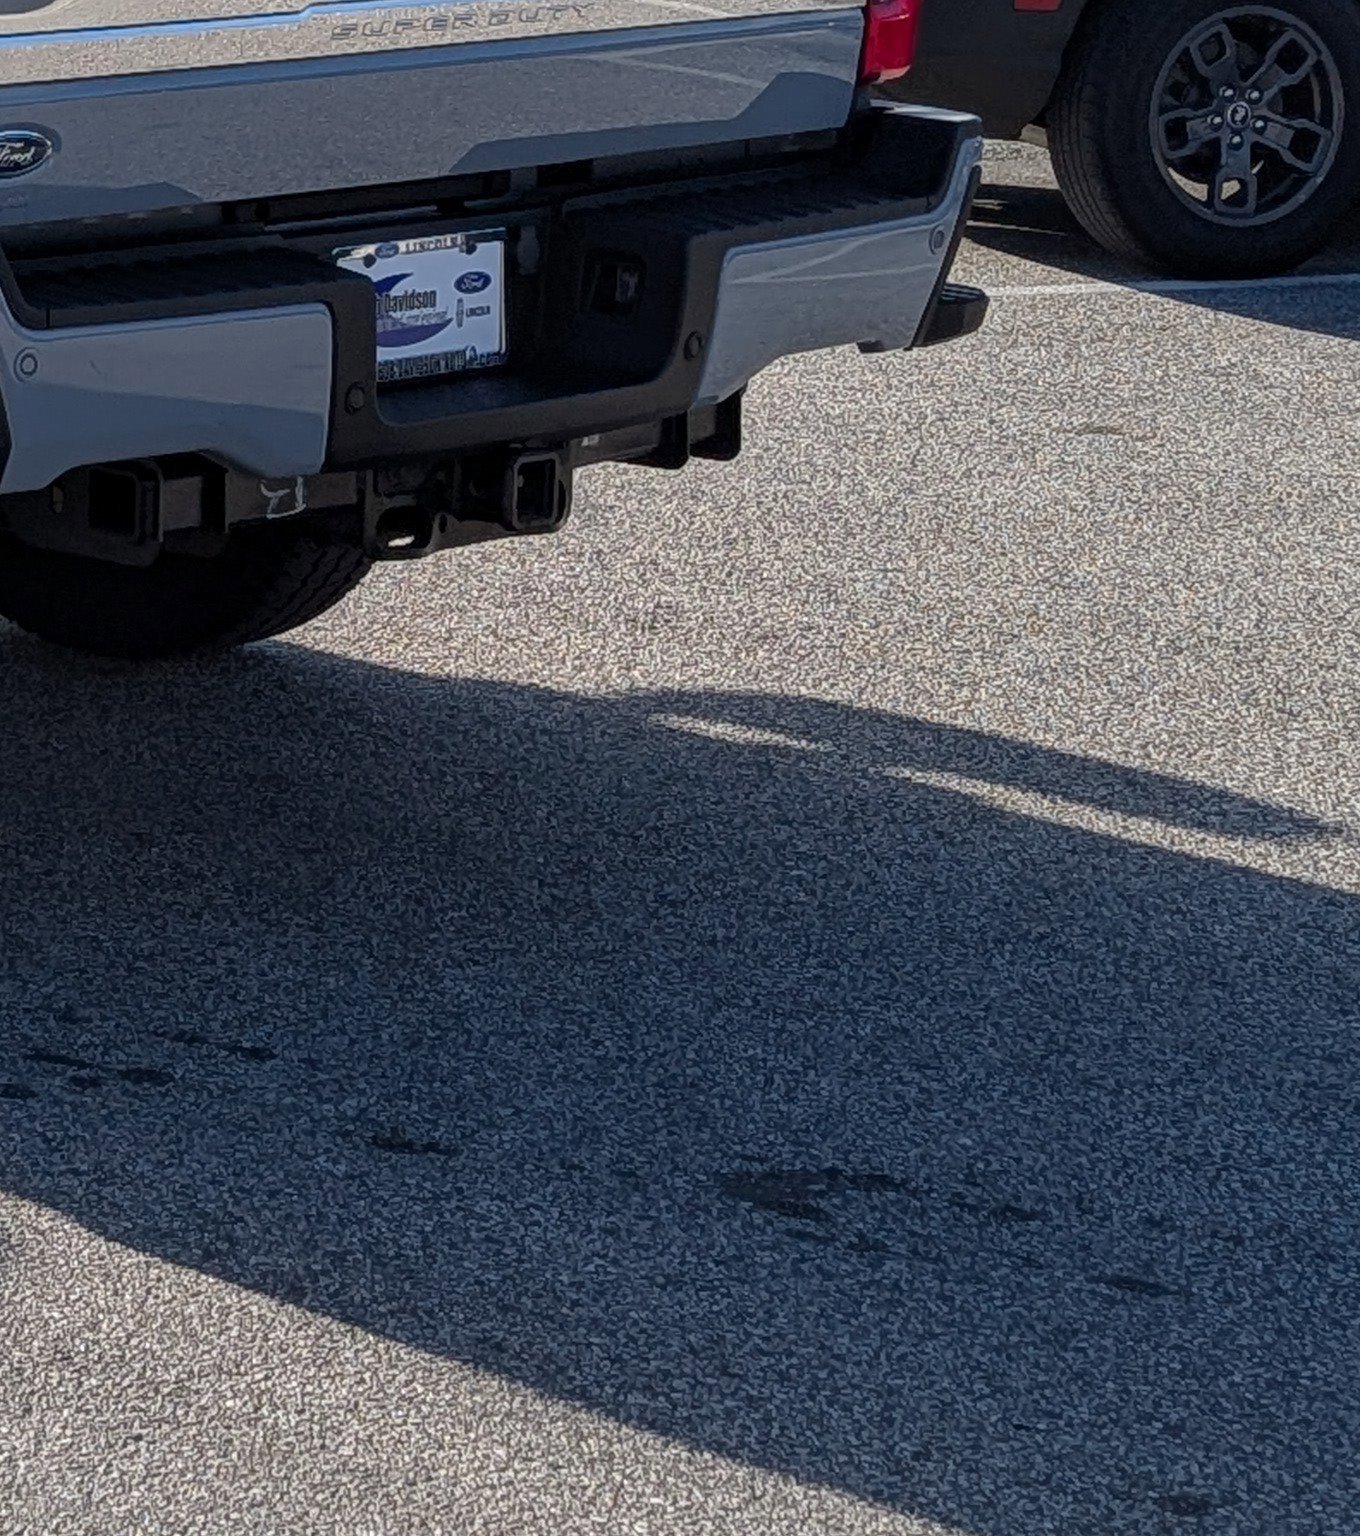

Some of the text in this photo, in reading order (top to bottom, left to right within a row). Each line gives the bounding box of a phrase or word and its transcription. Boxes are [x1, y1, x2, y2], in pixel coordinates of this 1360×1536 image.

[330, 0, 595, 41] SUPER DUTY
[384, 289, 438, 313] Davidson
